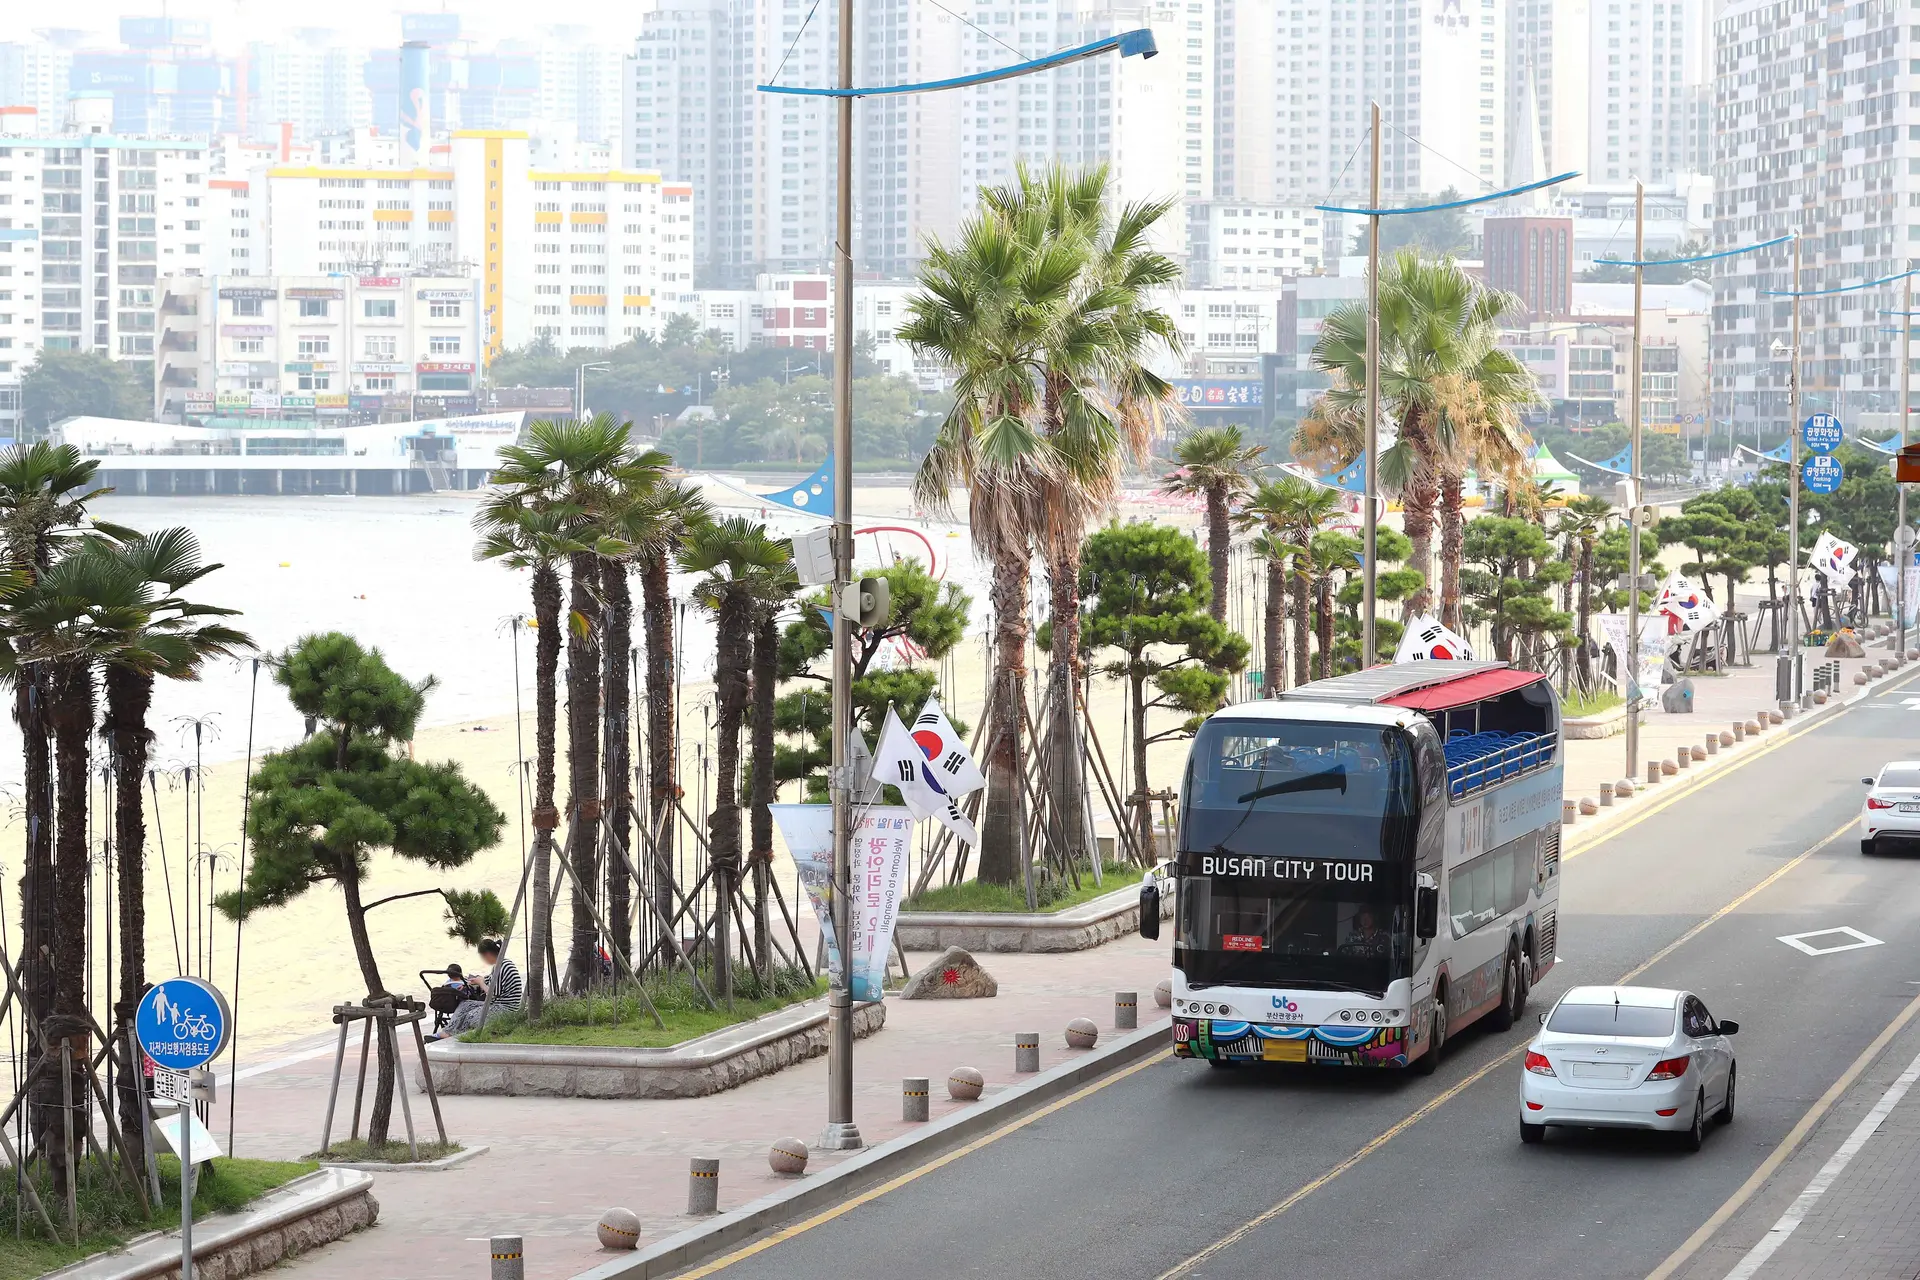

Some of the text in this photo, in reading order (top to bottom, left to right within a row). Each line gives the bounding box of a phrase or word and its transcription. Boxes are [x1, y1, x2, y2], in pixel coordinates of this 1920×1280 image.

[1433, 14, 1469, 28] 하늘채
[1208, 390, 1224, 401] 名品
[1807, 428, 1839, 437] 공중화장실
[1806, 468, 1839, 477] 공영주차장
[1202, 855, 1375, 884] BUSAN CITY TOUR
[1271, 995, 1298, 1013] bto
[1265, 1012, 1304, 1021] 부산관광공사
[149, 1042, 209, 1055] 자전거보행자겸용도로
